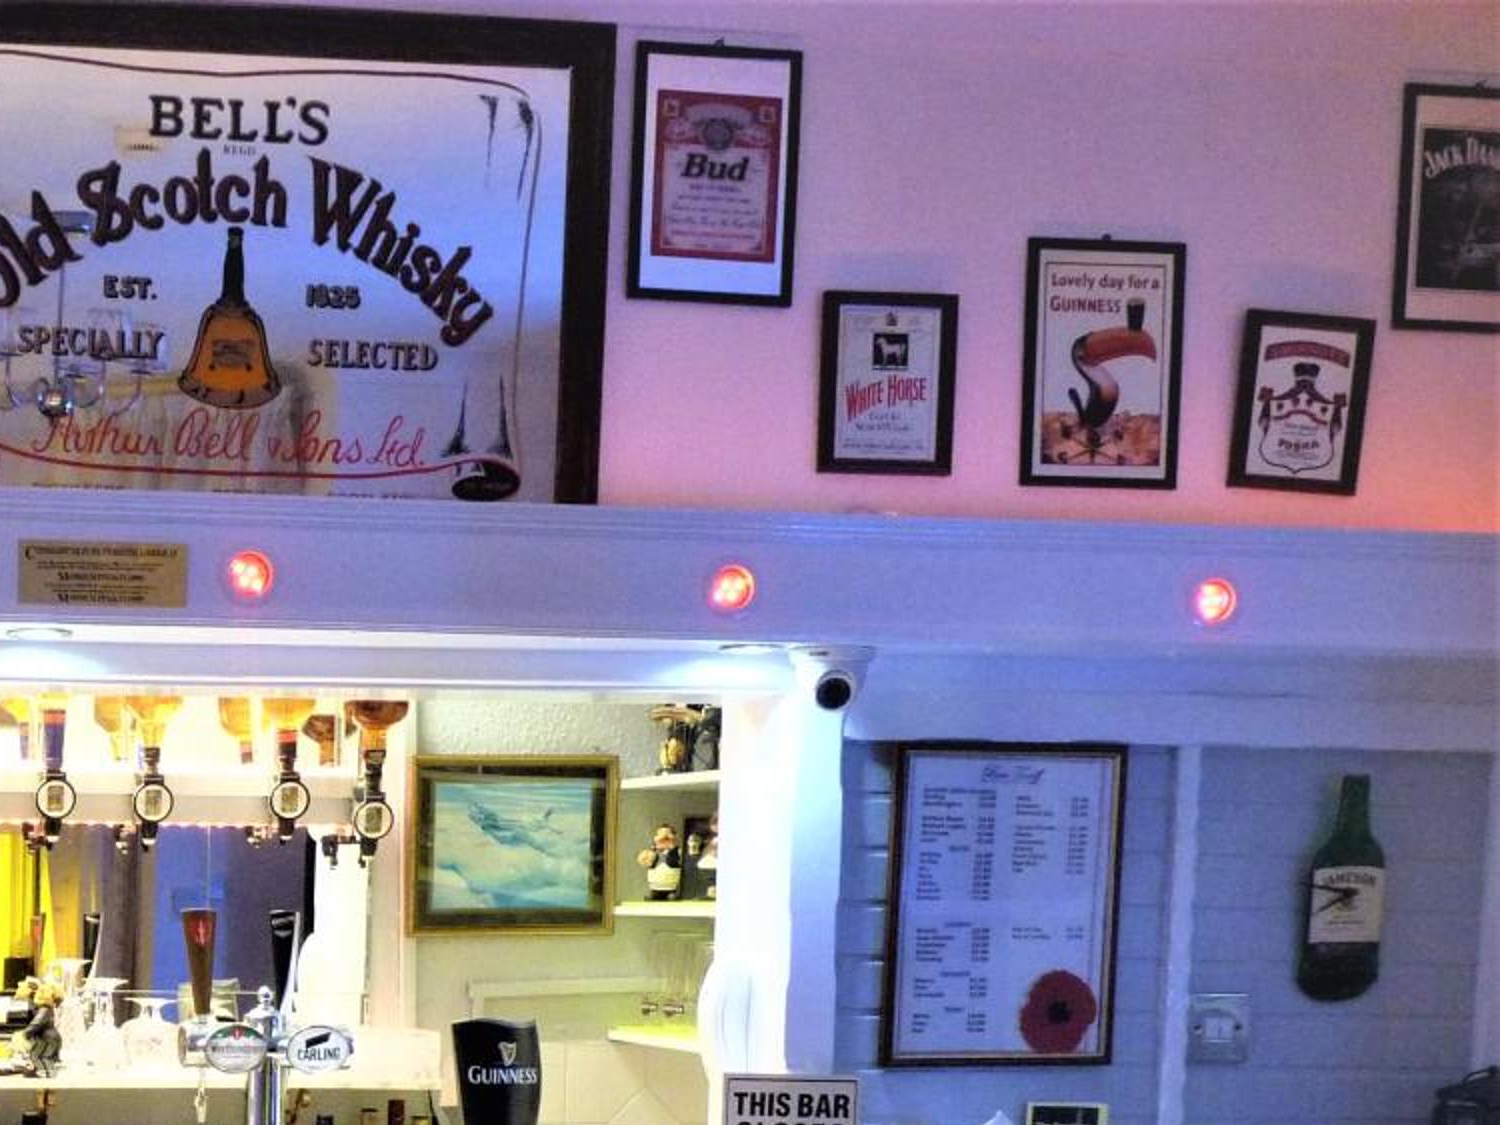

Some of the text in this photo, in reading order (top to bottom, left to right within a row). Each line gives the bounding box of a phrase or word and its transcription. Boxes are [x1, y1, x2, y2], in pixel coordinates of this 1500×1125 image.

[148, 94, 331, 146] BELL'S
[680, 153, 749, 182] Bud
[76, 146, 290, 247] Scotch
[308, 154, 494, 347] Whisky
[103, 275, 361, 309] EST. 1825
[1050, 271, 1160, 291] Lovely day for a
[1050, 296, 1122, 315] GUINNESS
[16, 324, 439, 372] SPECIALLY SELECTED
[845, 373, 928, 423] WHITE HORSE
[32, 410, 163, 458] Arthur
[174, 408, 261, 463] Bell
[283, 410, 363, 466] Sons
[366, 415, 427, 468] Ltd.
[297, 1047, 341, 1062] CARLING
[468, 1065, 538, 1085] GUINNESS
[733, 1091, 849, 1119] THIS BAR
